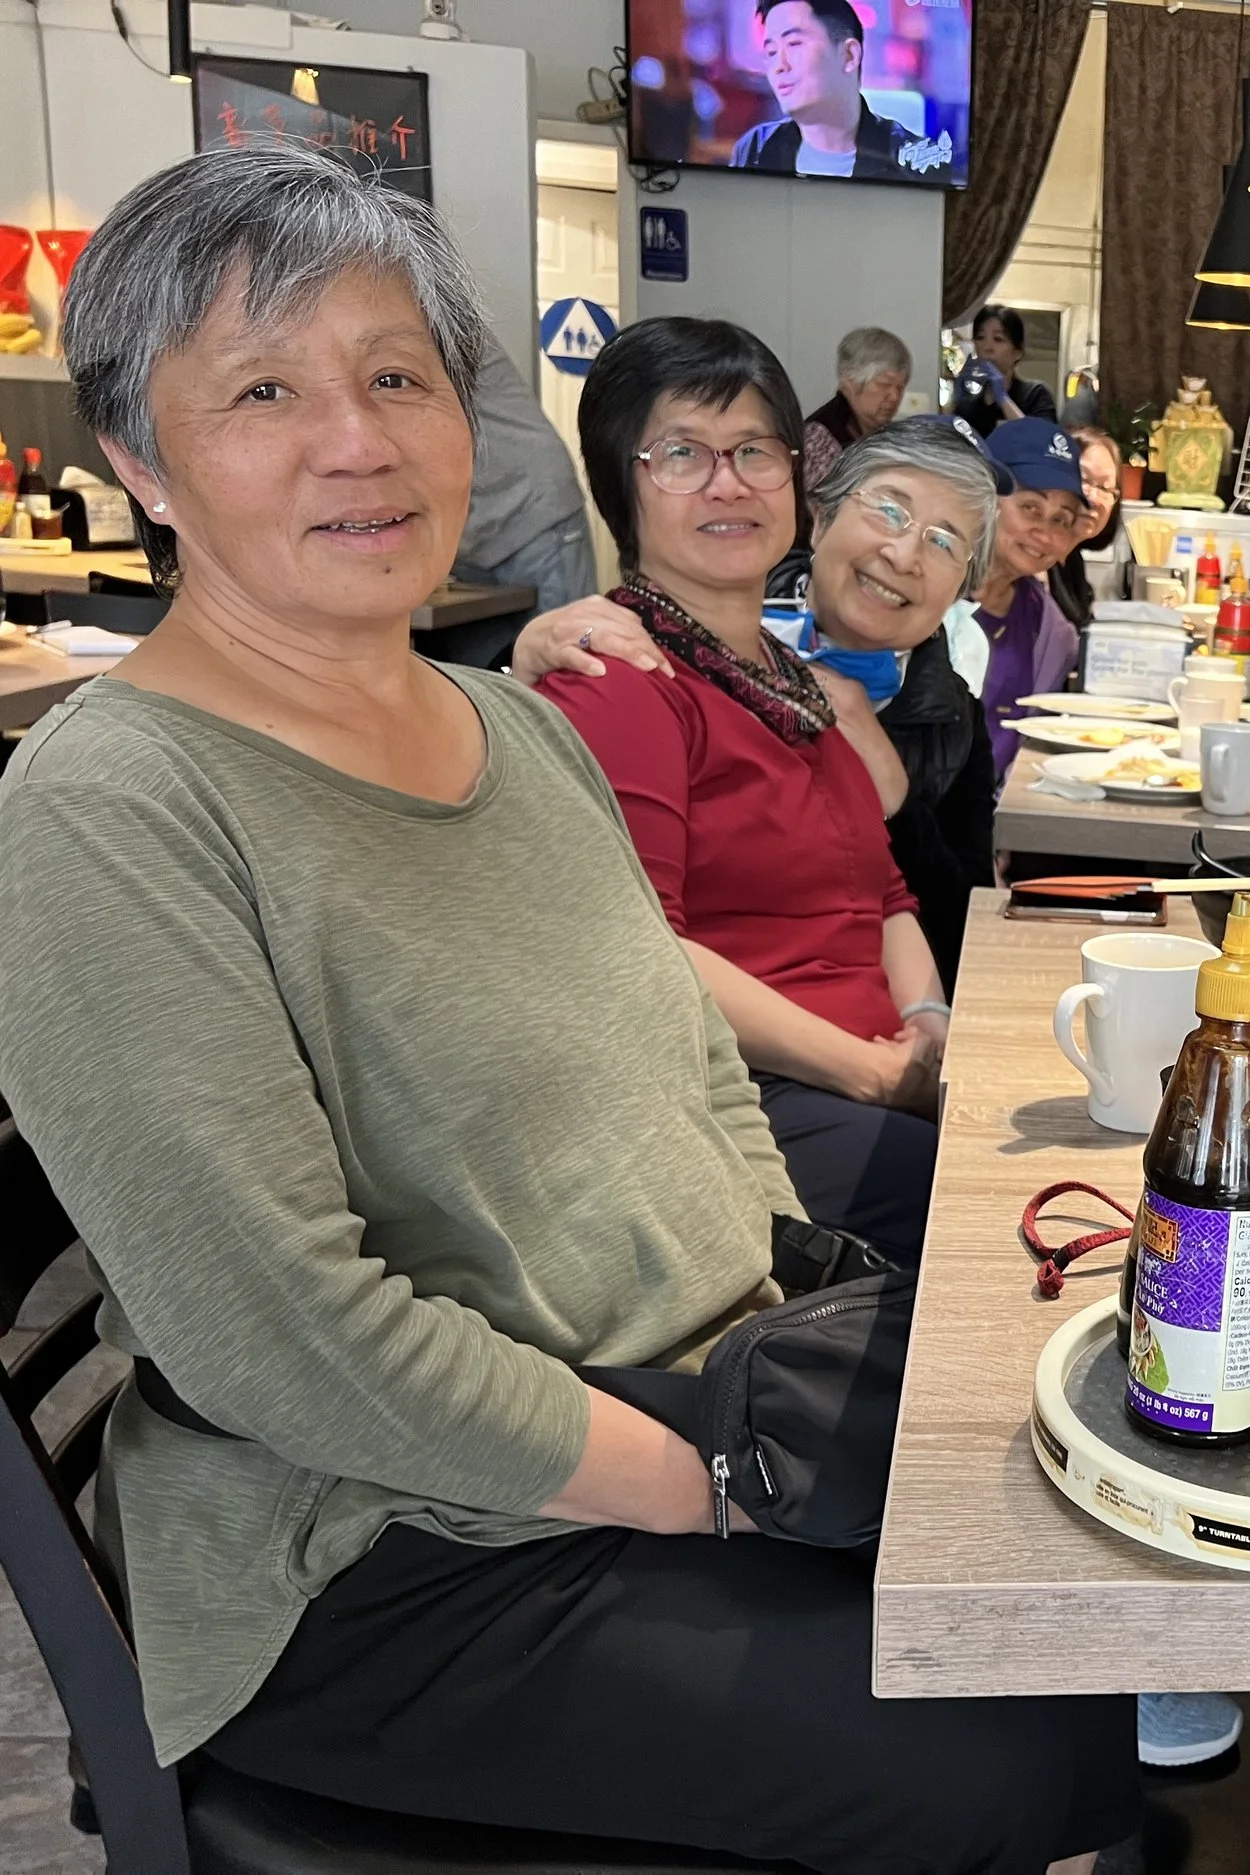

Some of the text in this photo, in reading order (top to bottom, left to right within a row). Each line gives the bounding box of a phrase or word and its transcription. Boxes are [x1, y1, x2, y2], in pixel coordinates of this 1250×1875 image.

[1141, 1272, 1168, 1299] SAUCE
[1154, 1399, 1162, 1411] lb
[1169, 1407, 1182, 1418] oz)
[1184, 1408, 1201, 1419] 567
[1202, 1411, 1209, 1422] g
[1198, 1525, 1207, 1533] 9"
